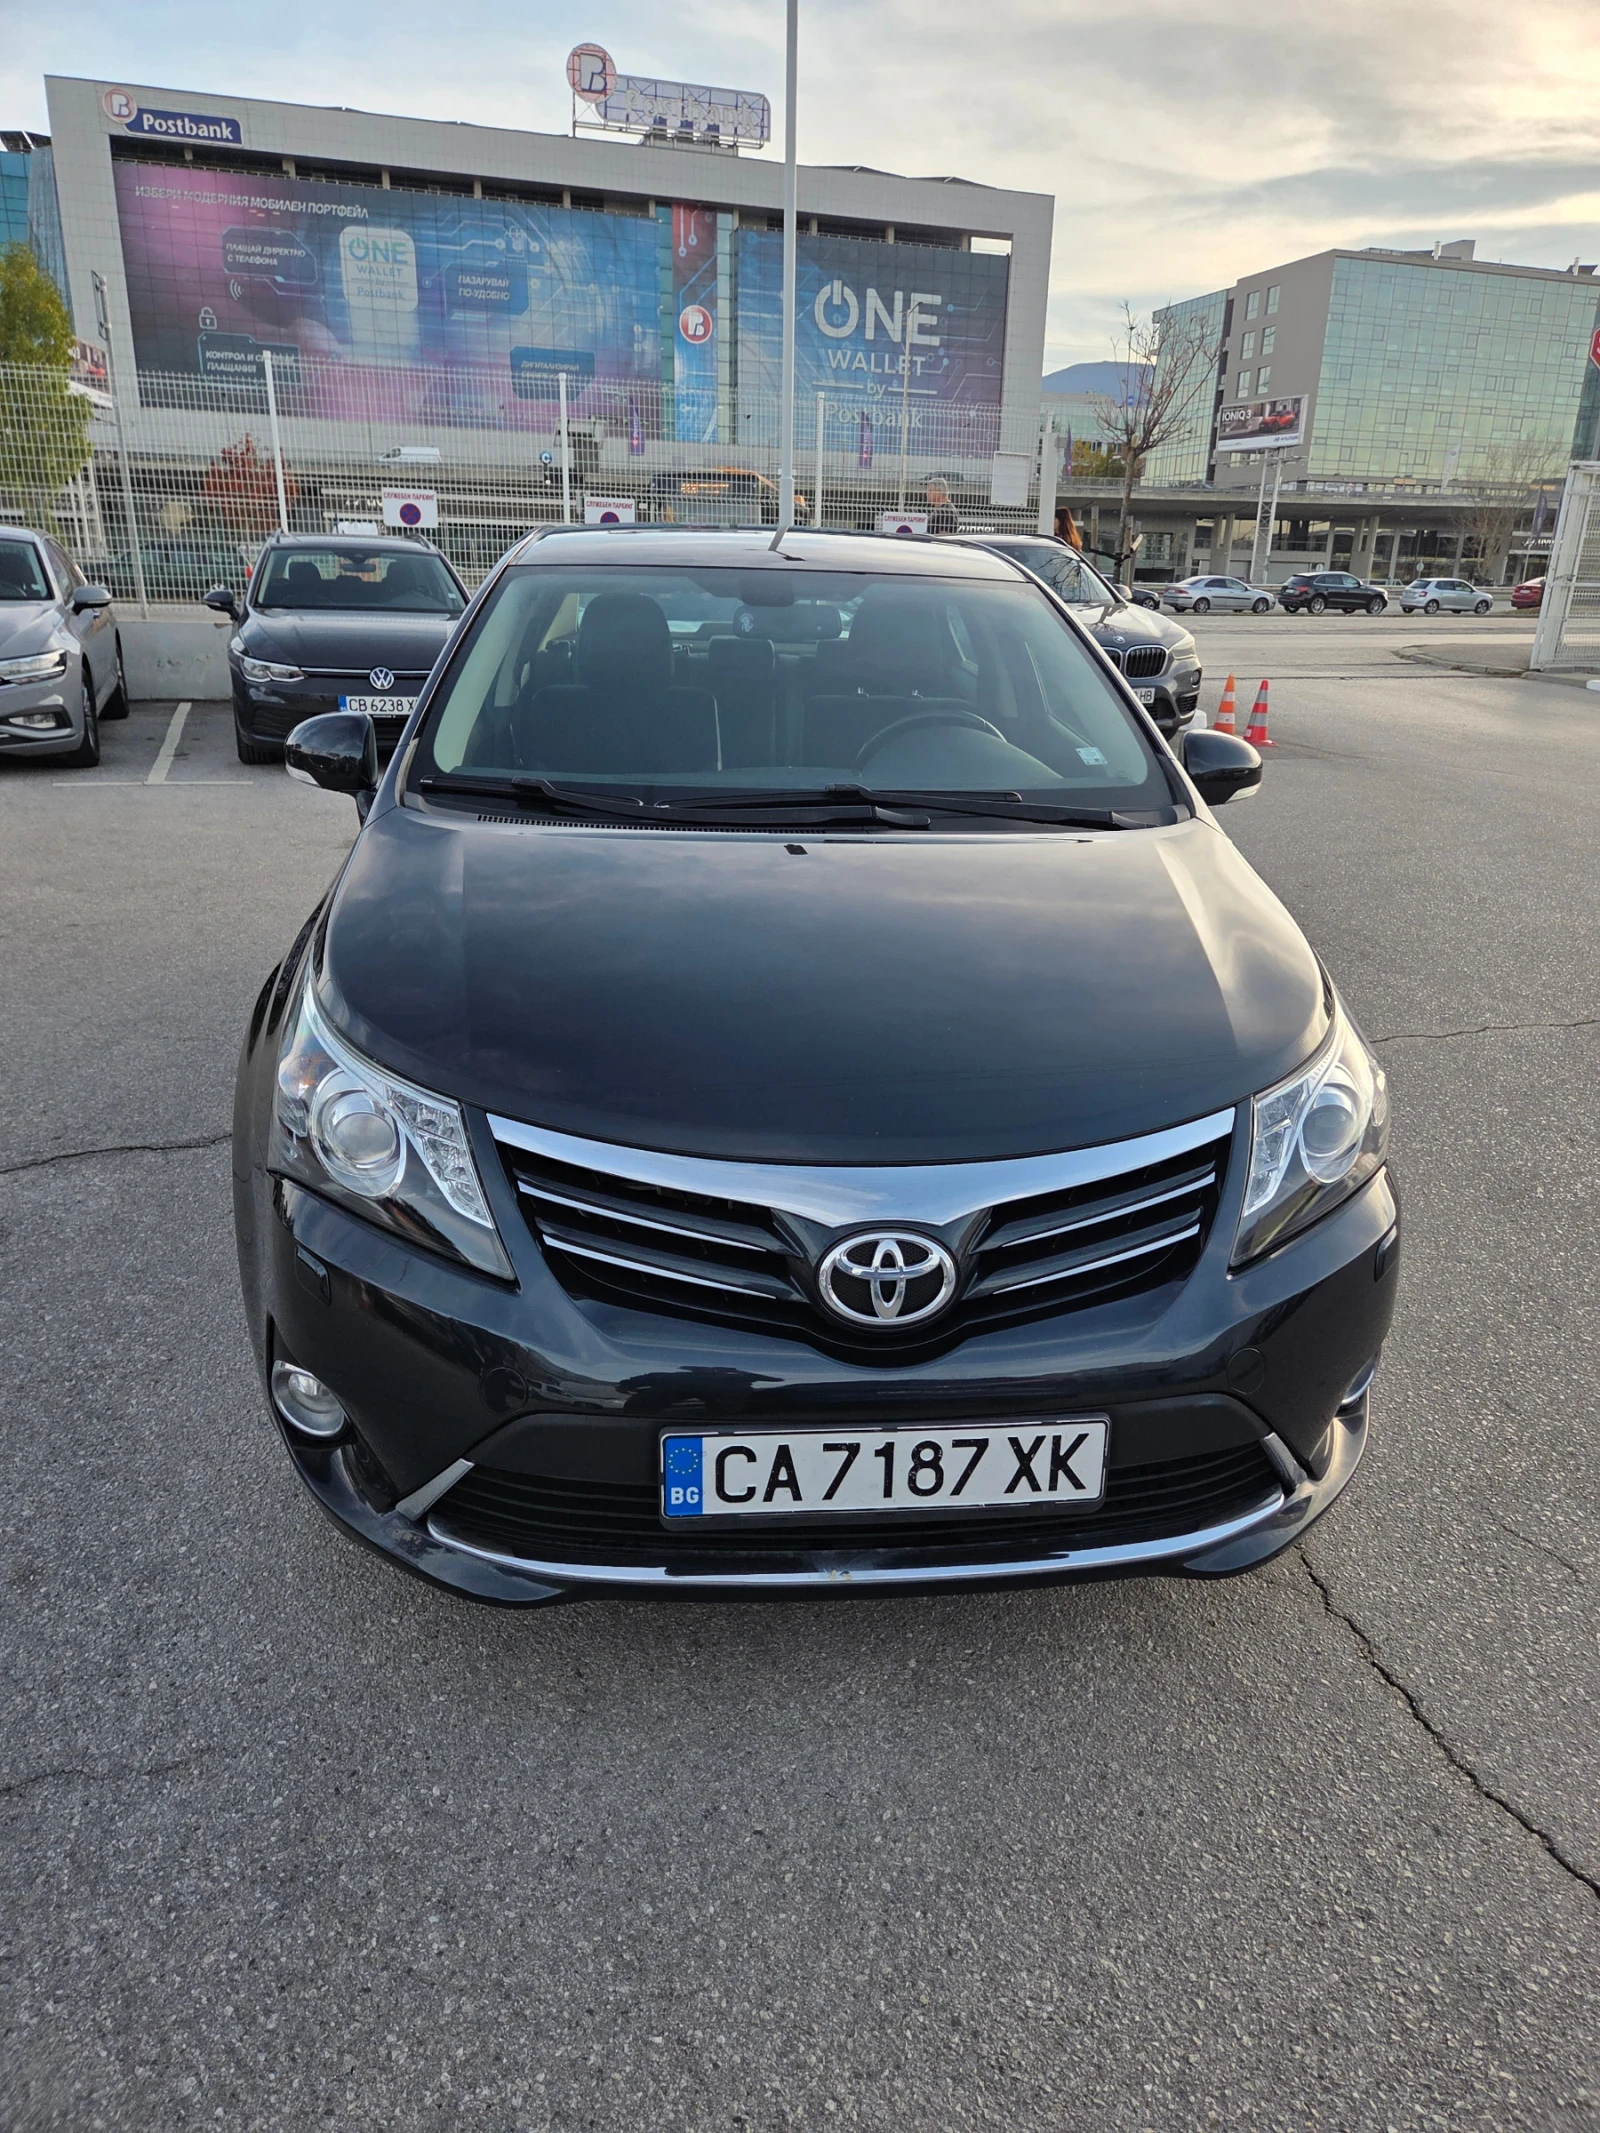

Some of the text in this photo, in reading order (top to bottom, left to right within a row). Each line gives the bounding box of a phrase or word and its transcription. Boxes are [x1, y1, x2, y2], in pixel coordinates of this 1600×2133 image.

[625, 87, 758, 131] Postbank
[142, 113, 234, 141] Postbank
[135, 186, 369, 219] ИЗБЕРИ МОДЕРНИЯ МОБИЛЕН ПОРТФЕЙЛ
[235, 254, 278, 266] ТЕЛЕФОНА
[349, 236, 408, 264] ONE
[356, 264, 403, 277] WALLET
[357, 285, 405, 299] Postbank
[814, 279, 942, 347] ONE
[827, 348, 926, 377] WALLET
[866, 378, 886, 399] by
[1221, 409, 1246, 422] IONIQ
[348, 698, 368, 713] CB
[370, 698, 404, 713] 6238
[715, 1432, 1090, 1504] CA 7187 XK
[670, 1486, 700, 1505] BG
